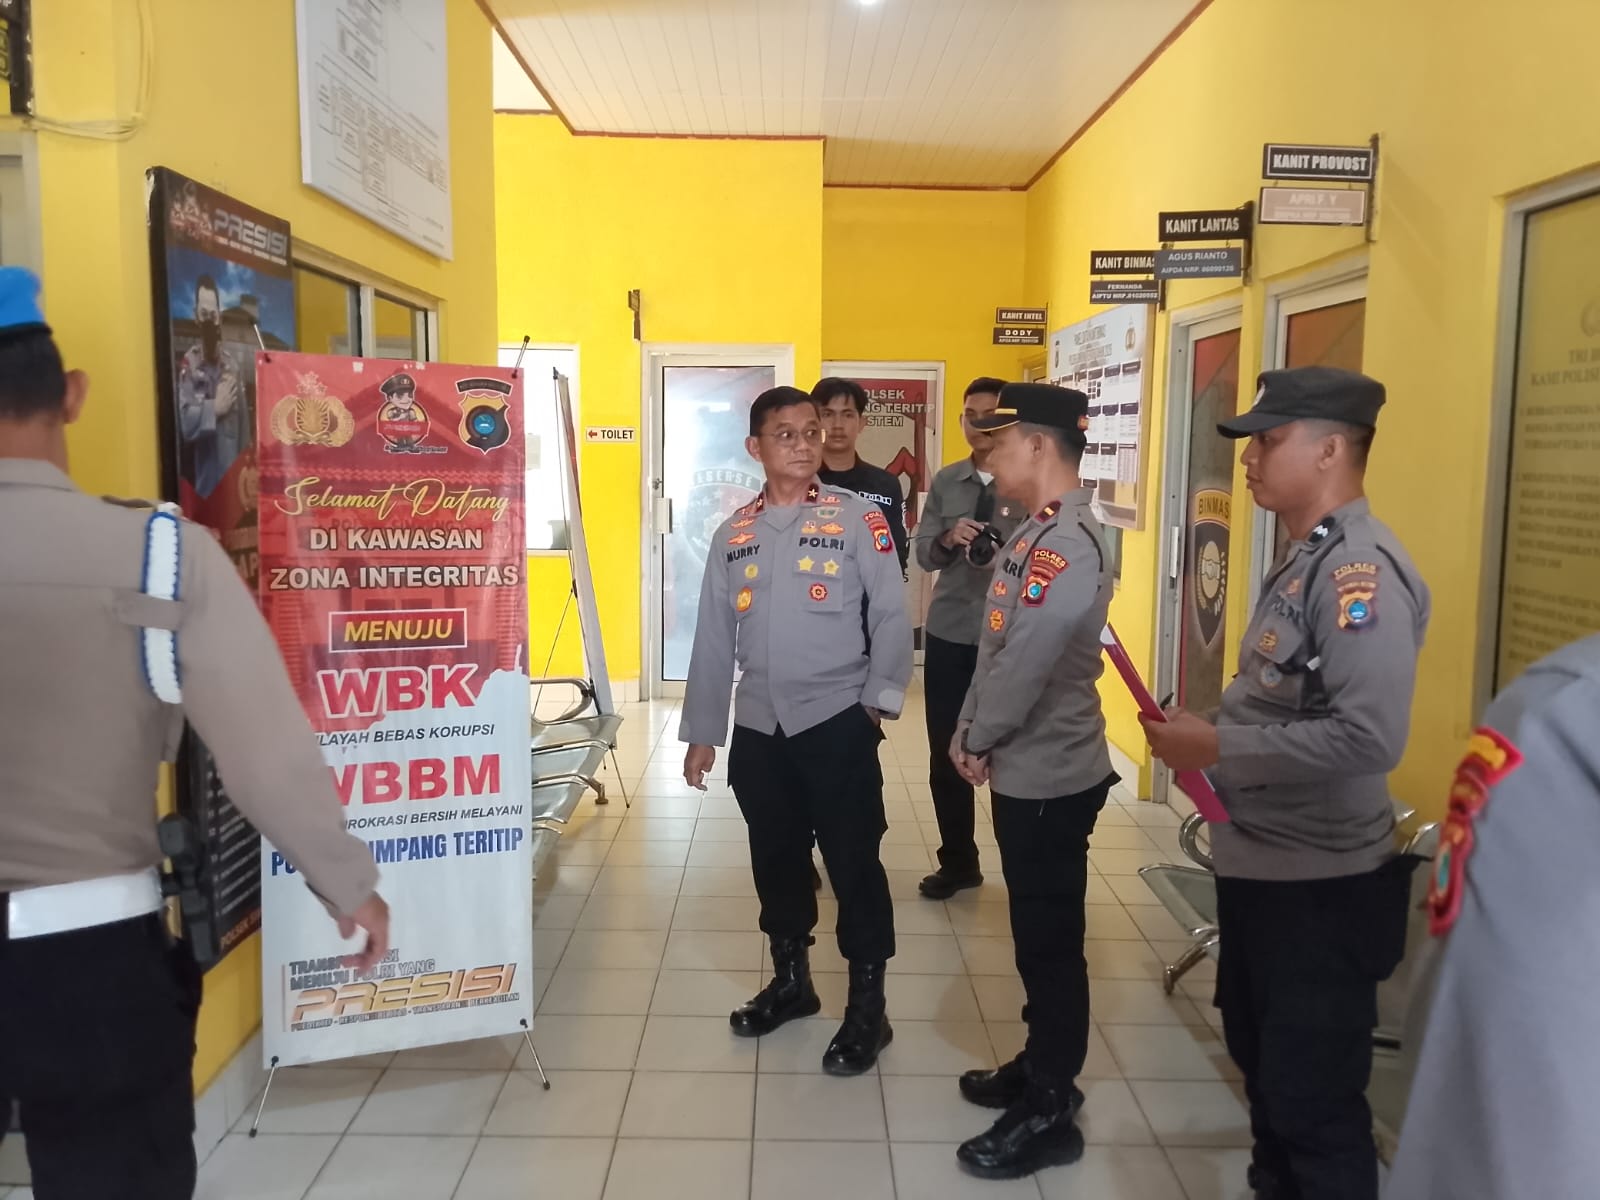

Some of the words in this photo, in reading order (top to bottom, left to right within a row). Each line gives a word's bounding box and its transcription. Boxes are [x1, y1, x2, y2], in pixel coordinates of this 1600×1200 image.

[1273, 154, 1310, 169] KANIT
[1311, 155, 1368, 171] PROVOST
[214, 208, 288, 258] PRESISI
[1165, 219, 1198, 234] KANIT
[1200, 217, 1240, 232] LANTAS
[1095, 256, 1123, 269] KANIT
[1168, 252, 1193, 261] AGUS
[1194, 251, 1228, 260] RIANTO
[1001, 312, 1023, 320] KANIT
[1024, 312, 1043, 320] INTEL
[863, 389, 905, 400] OLSEK
[867, 416, 904, 426] STEM
[600, 429, 634, 440] TOILET
[697, 470, 753, 488] ESERSE
[274, 476, 408, 521] Selamat
[403, 478, 510, 521] Datang
[1198, 496, 1230, 520] BINMAS
[309, 528, 337, 550] DI
[347, 527, 483, 551] KAWASAN
[799, 536, 845, 551] POLRI
[1034, 550, 1066, 569] POLRES
[1334, 562, 1377, 576] POLRES
[270, 567, 350, 590] ZONA
[359, 565, 519, 588] INTEGRITAS
[343, 618, 454, 643] MENUJU
[318, 664, 478, 718] WBK
[316, 732, 370, 747] LAYAH
[373, 728, 425, 743] BEBAS
[428, 724, 496, 739] KORUPSI
[345, 813, 409, 831] IROKRASI
[410, 809, 459, 825] BERSIH
[460, 804, 523, 820] MELAYANI
[368, 833, 447, 864] IMPANG
[453, 827, 523, 856] TERITIP
[290, 968, 350, 991] MENUJU
[398, 958, 436, 976] YANG
[291, 962, 518, 1023] PRESISI
